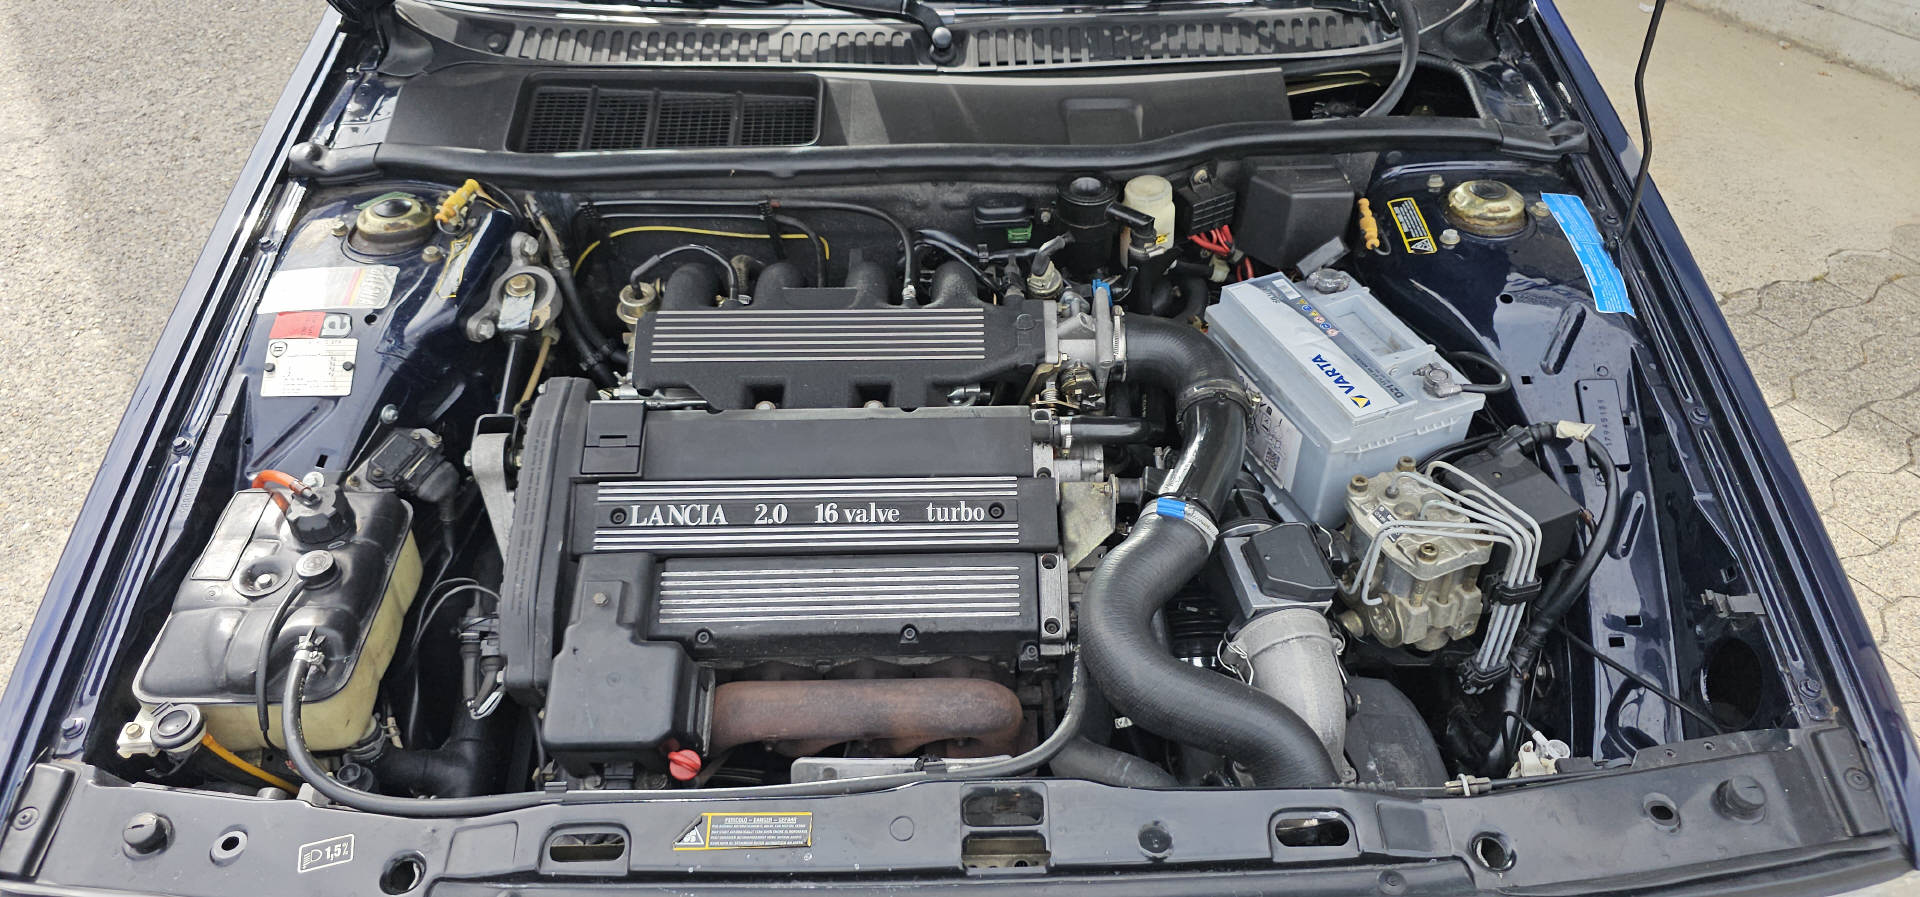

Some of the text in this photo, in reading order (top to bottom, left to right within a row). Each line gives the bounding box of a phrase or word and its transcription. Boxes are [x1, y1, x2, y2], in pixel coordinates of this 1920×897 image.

[1311, 353, 1356, 396] VARTA
[1386, 383, 1405, 399] D21
[629, 502, 985, 526] LANCIA 2.0 16 valve turbo
